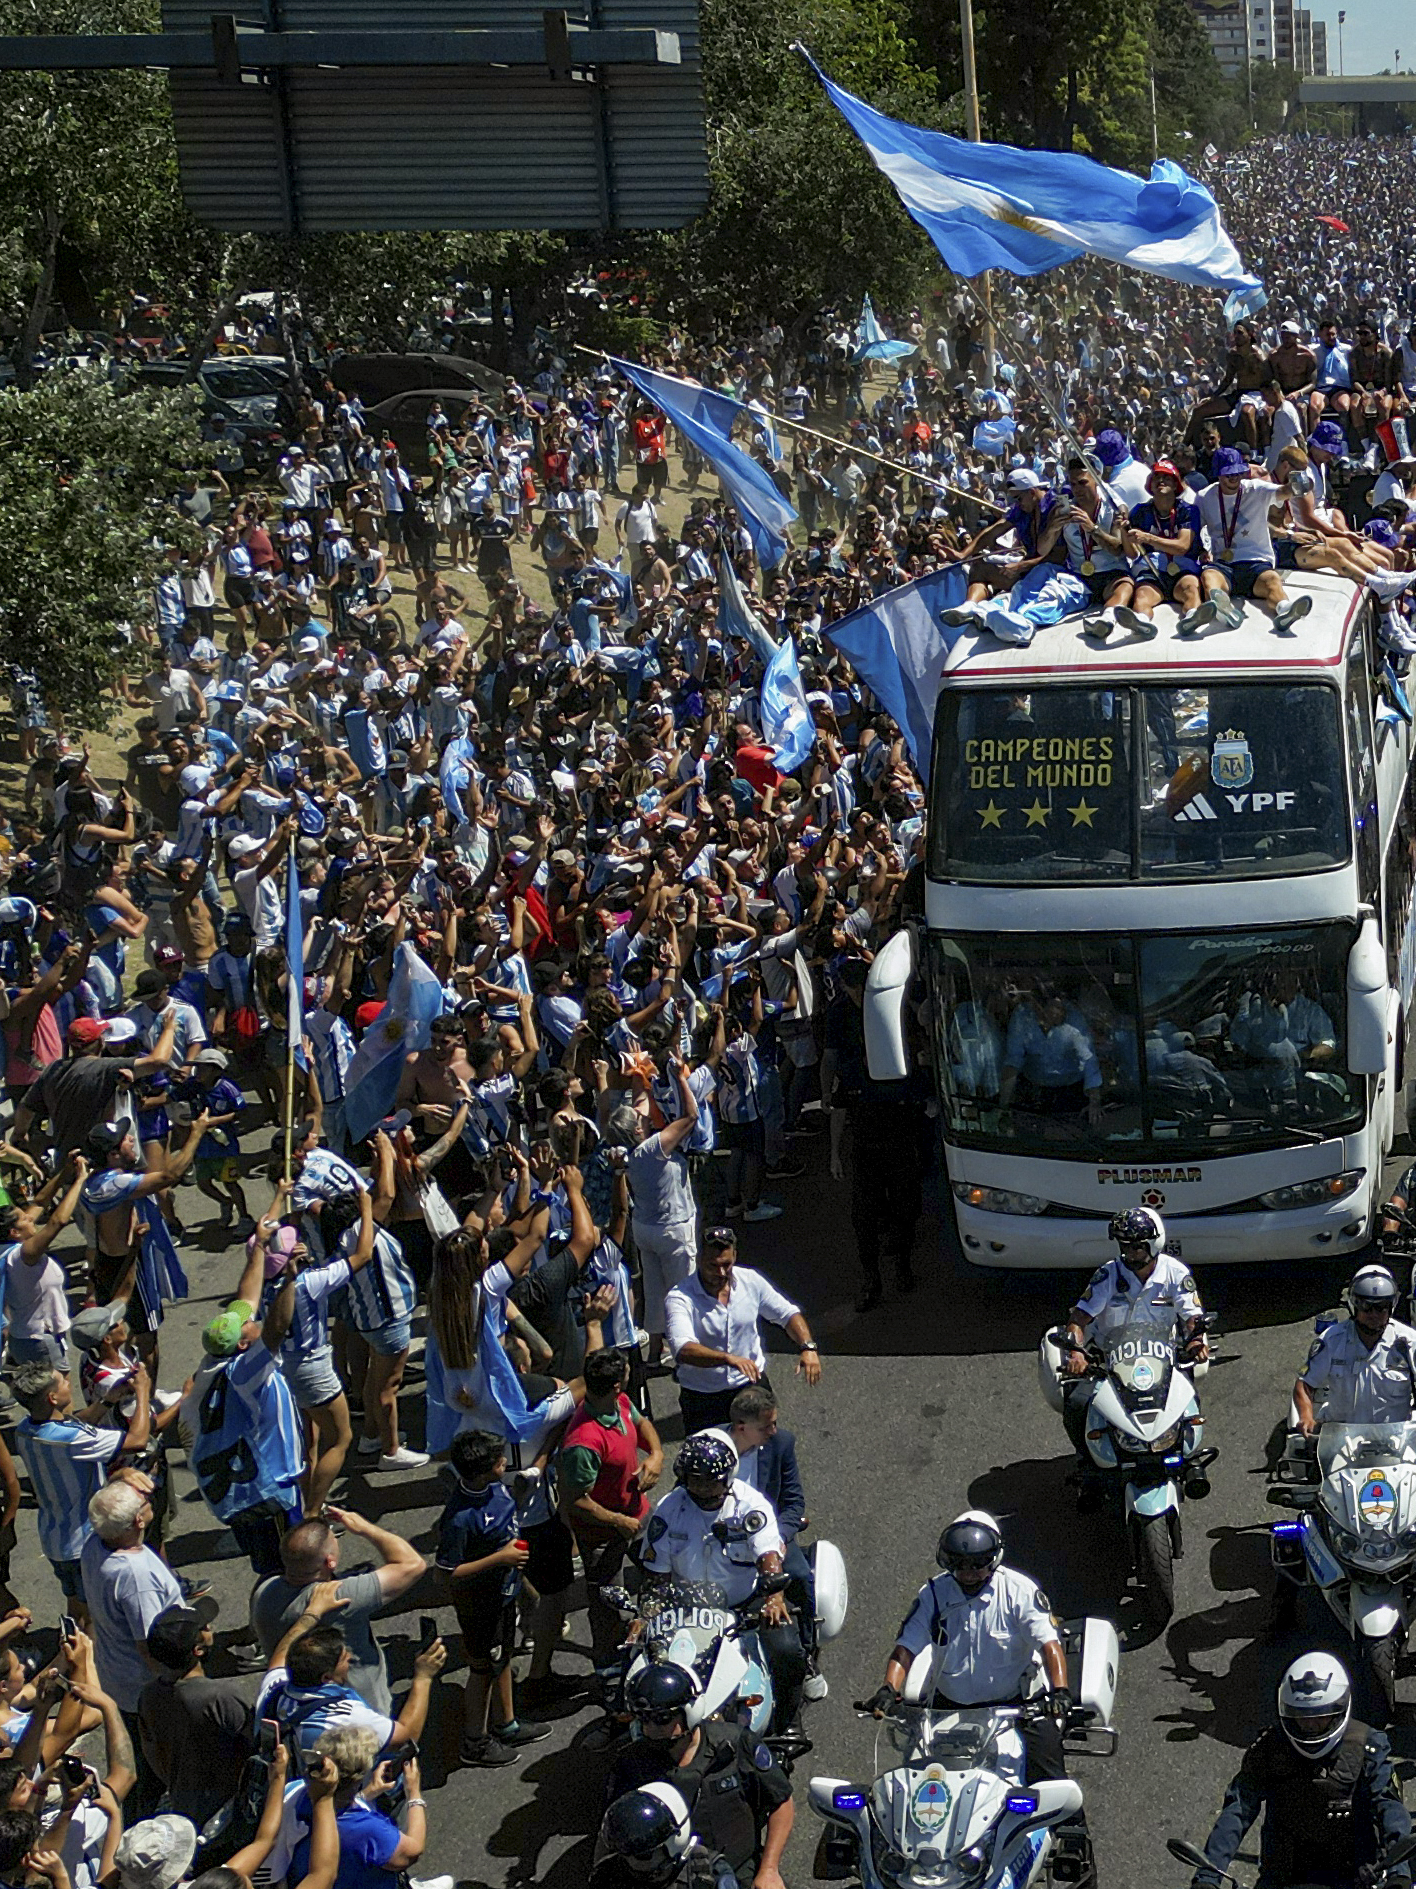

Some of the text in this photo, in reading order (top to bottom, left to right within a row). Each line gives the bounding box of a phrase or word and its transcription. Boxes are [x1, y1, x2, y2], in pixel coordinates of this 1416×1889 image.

[965, 737, 1113, 762] CAMPEONES
[970, 764, 1111, 788] DEL MUNDO
[1225, 792, 1295, 812] YPF
[1097, 1167, 1202, 1184] PLUSMAR
